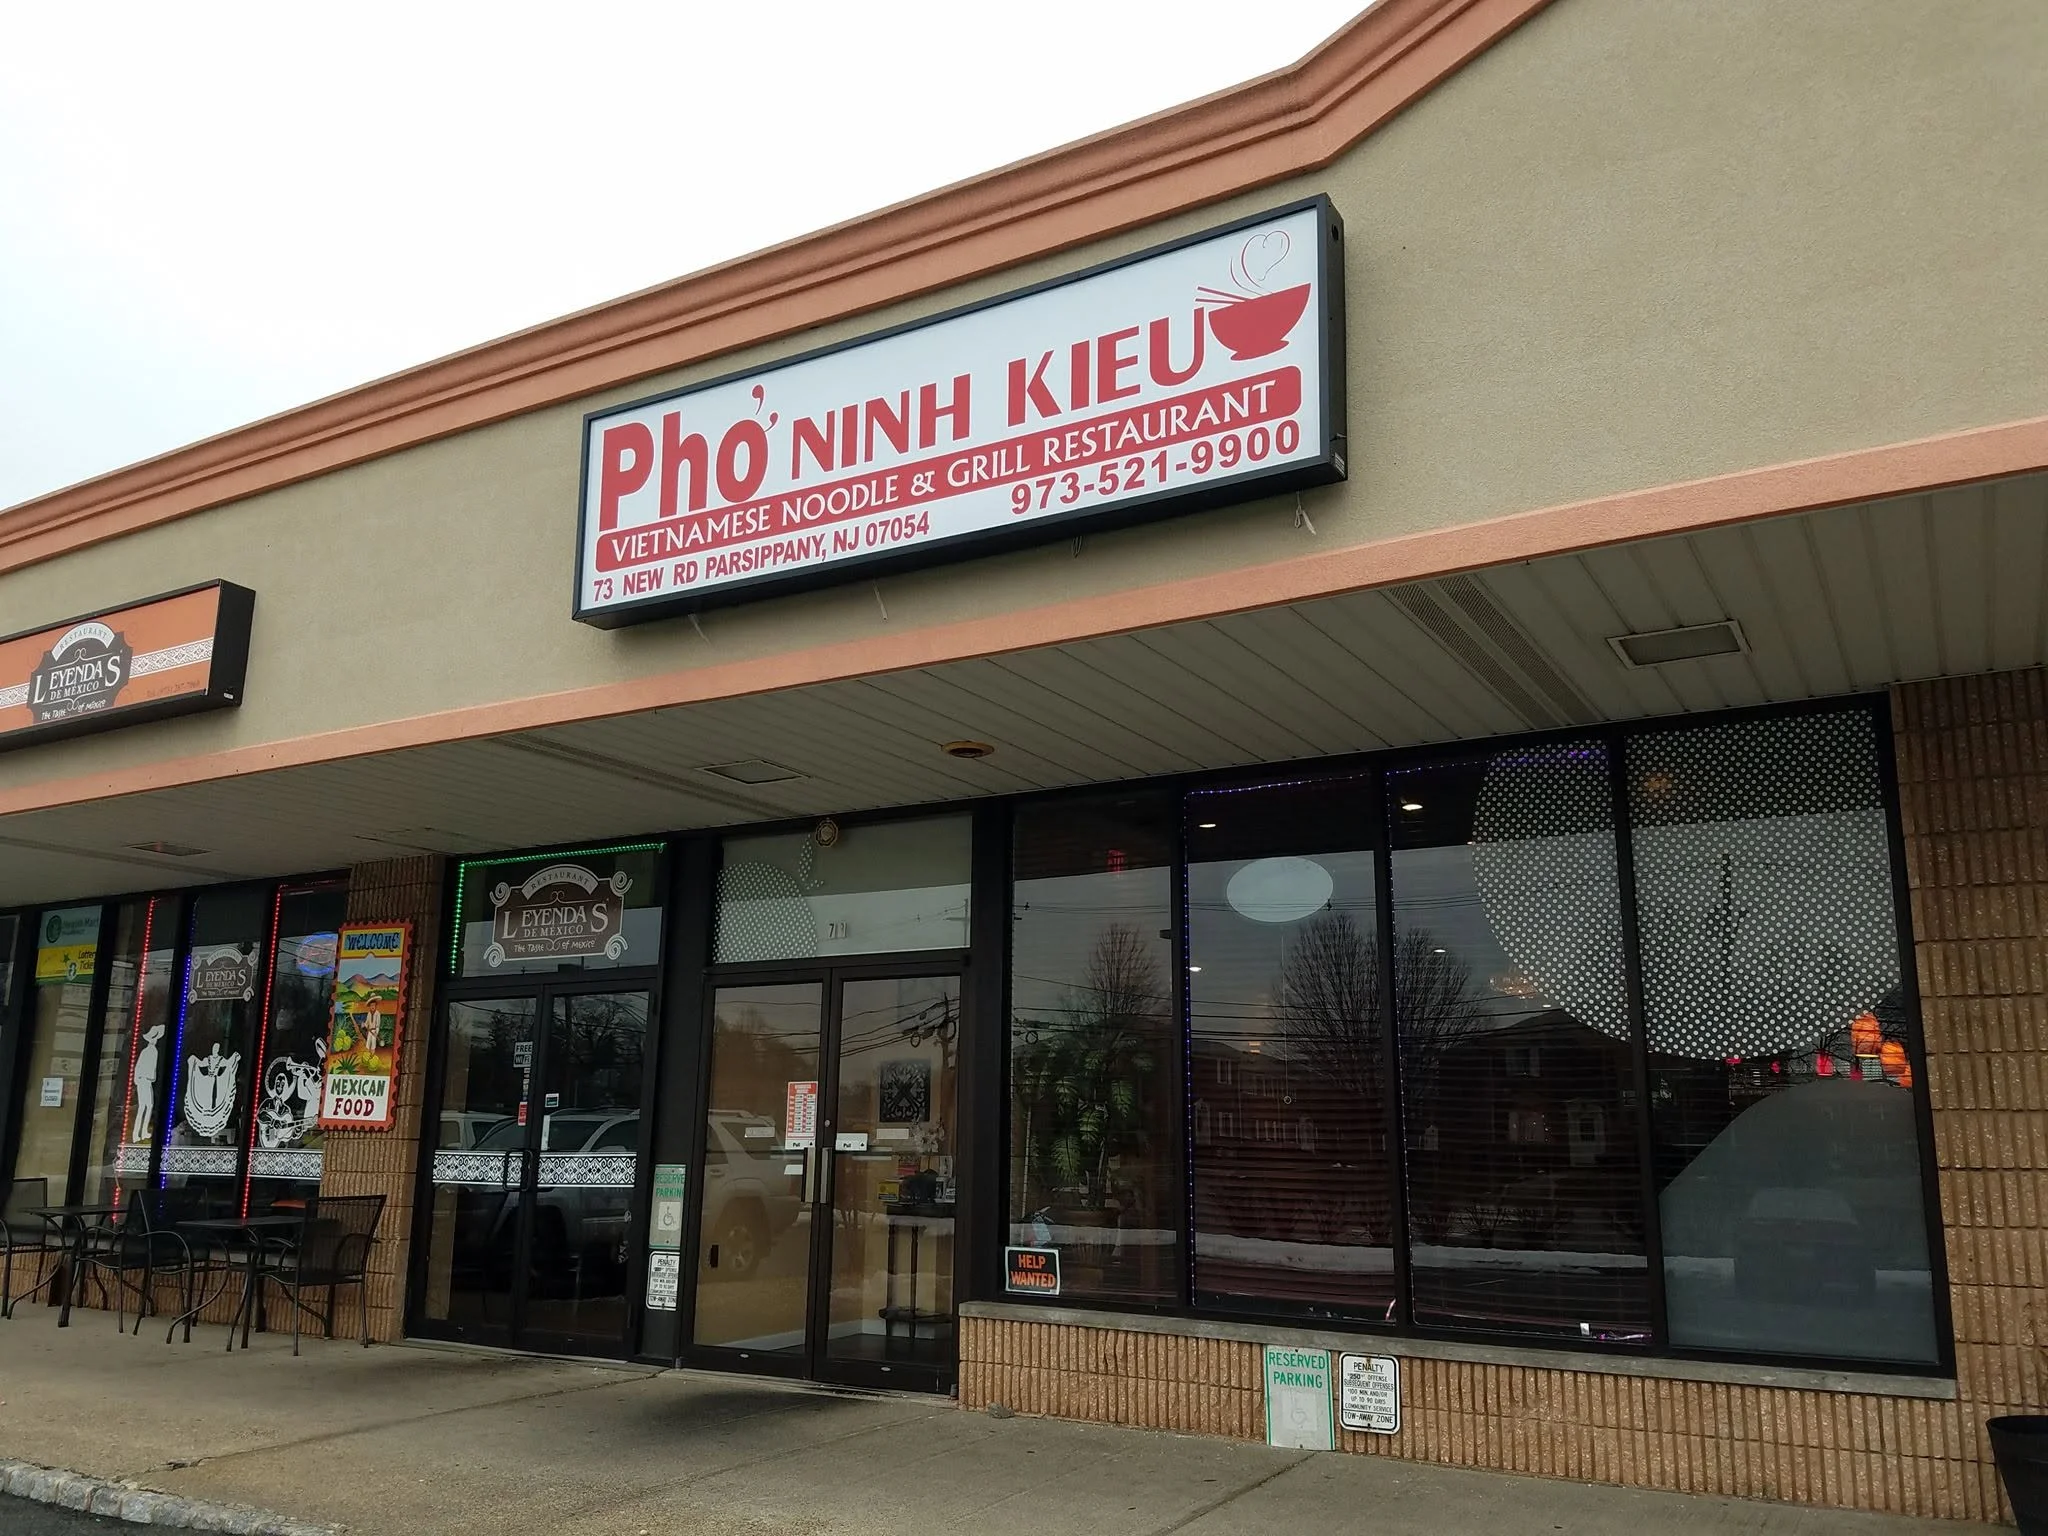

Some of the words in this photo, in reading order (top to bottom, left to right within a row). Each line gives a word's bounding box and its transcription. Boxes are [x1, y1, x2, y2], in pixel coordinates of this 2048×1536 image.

[792, 373, 971, 480] NINH
[1007, 307, 1205, 428] KIEU
[611, 504, 771, 562] VIETNAMESE
[782, 475, 899, 526] NOODLE
[911, 471, 936, 497] &
[947, 444, 1031, 487] GRILL
[1043, 380, 1276, 467] RESTAURANT
[1011, 419, 1300, 515] 973-521-9900
[593, 578, 614, 601] 73
[623, 567, 664, 596] NEW
[673, 560, 699, 586] RD
[705, 533, 827, 579] PARSIPPANY,
[833, 526, 860, 553] NJ
[865, 511, 929, 546] 07054
[50, 690, 62, 701] DE
[530, 871, 590, 890] RESTAURANT
[347, 931, 401, 953] WELCOME
[524, 929, 537, 938] DE
[78, 950, 96, 960] Lotter
[516, 1044, 533, 1053] FREE
[330, 1077, 386, 1098] MEXICAN
[333, 1098, 375, 1117] FOOD
[655, 1173, 686, 1185] RESERVE
[655, 1187, 684, 1198] PARKIN
[1018, 1254, 1046, 1269] HELP
[1011, 1271, 1056, 1288] WANTED
[1269, 1351, 1326, 1370] RESERVED
[1353, 1361, 1385, 1373] PENALTY
[1273, 1371, 1323, 1389] PARKING
[1376, 1415, 1393, 1424] ZONE
